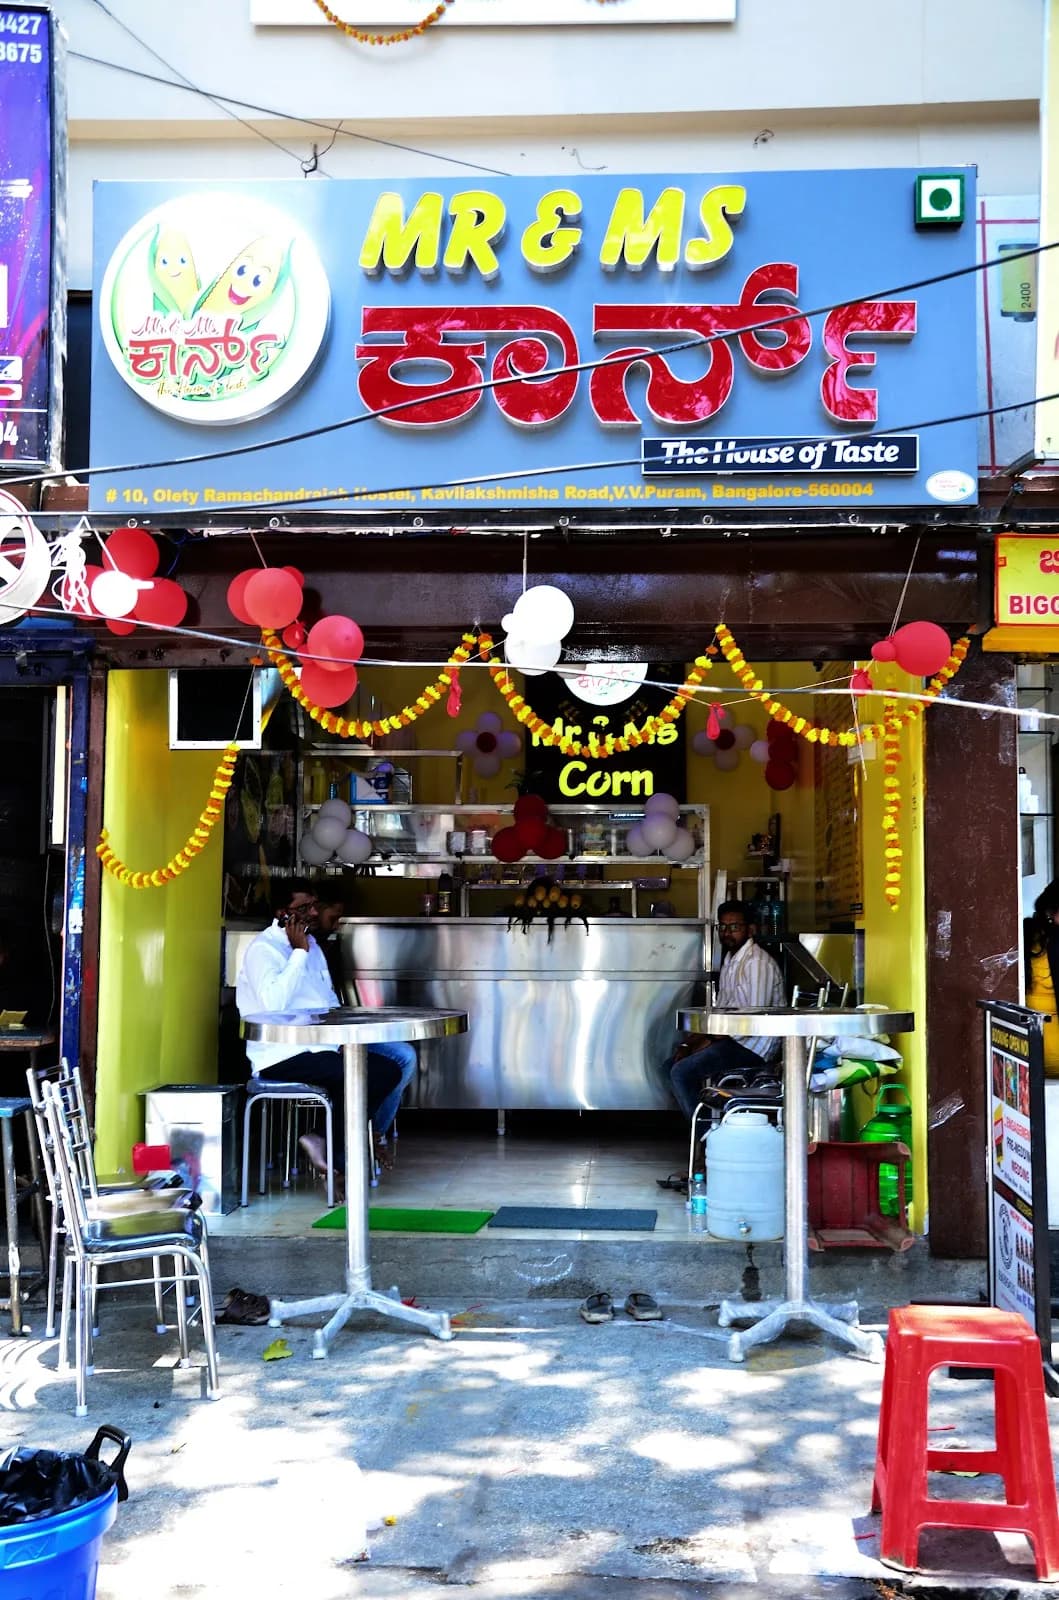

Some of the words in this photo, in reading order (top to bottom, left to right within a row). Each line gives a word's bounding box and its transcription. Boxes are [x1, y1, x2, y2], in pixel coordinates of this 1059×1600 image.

[359, 190, 506, 278] MR
[521, 189, 583, 271] &
[599, 184, 746, 271] MS
[1020, 282, 1032, 309] 2400
[660, 441, 709, 464] The
[712, 441, 795, 464] House
[798, 443, 827, 470] of
[831, 440, 900, 463] Taste
[122, 488, 149, 504] 10,
[558, 760, 653, 797] Corn
